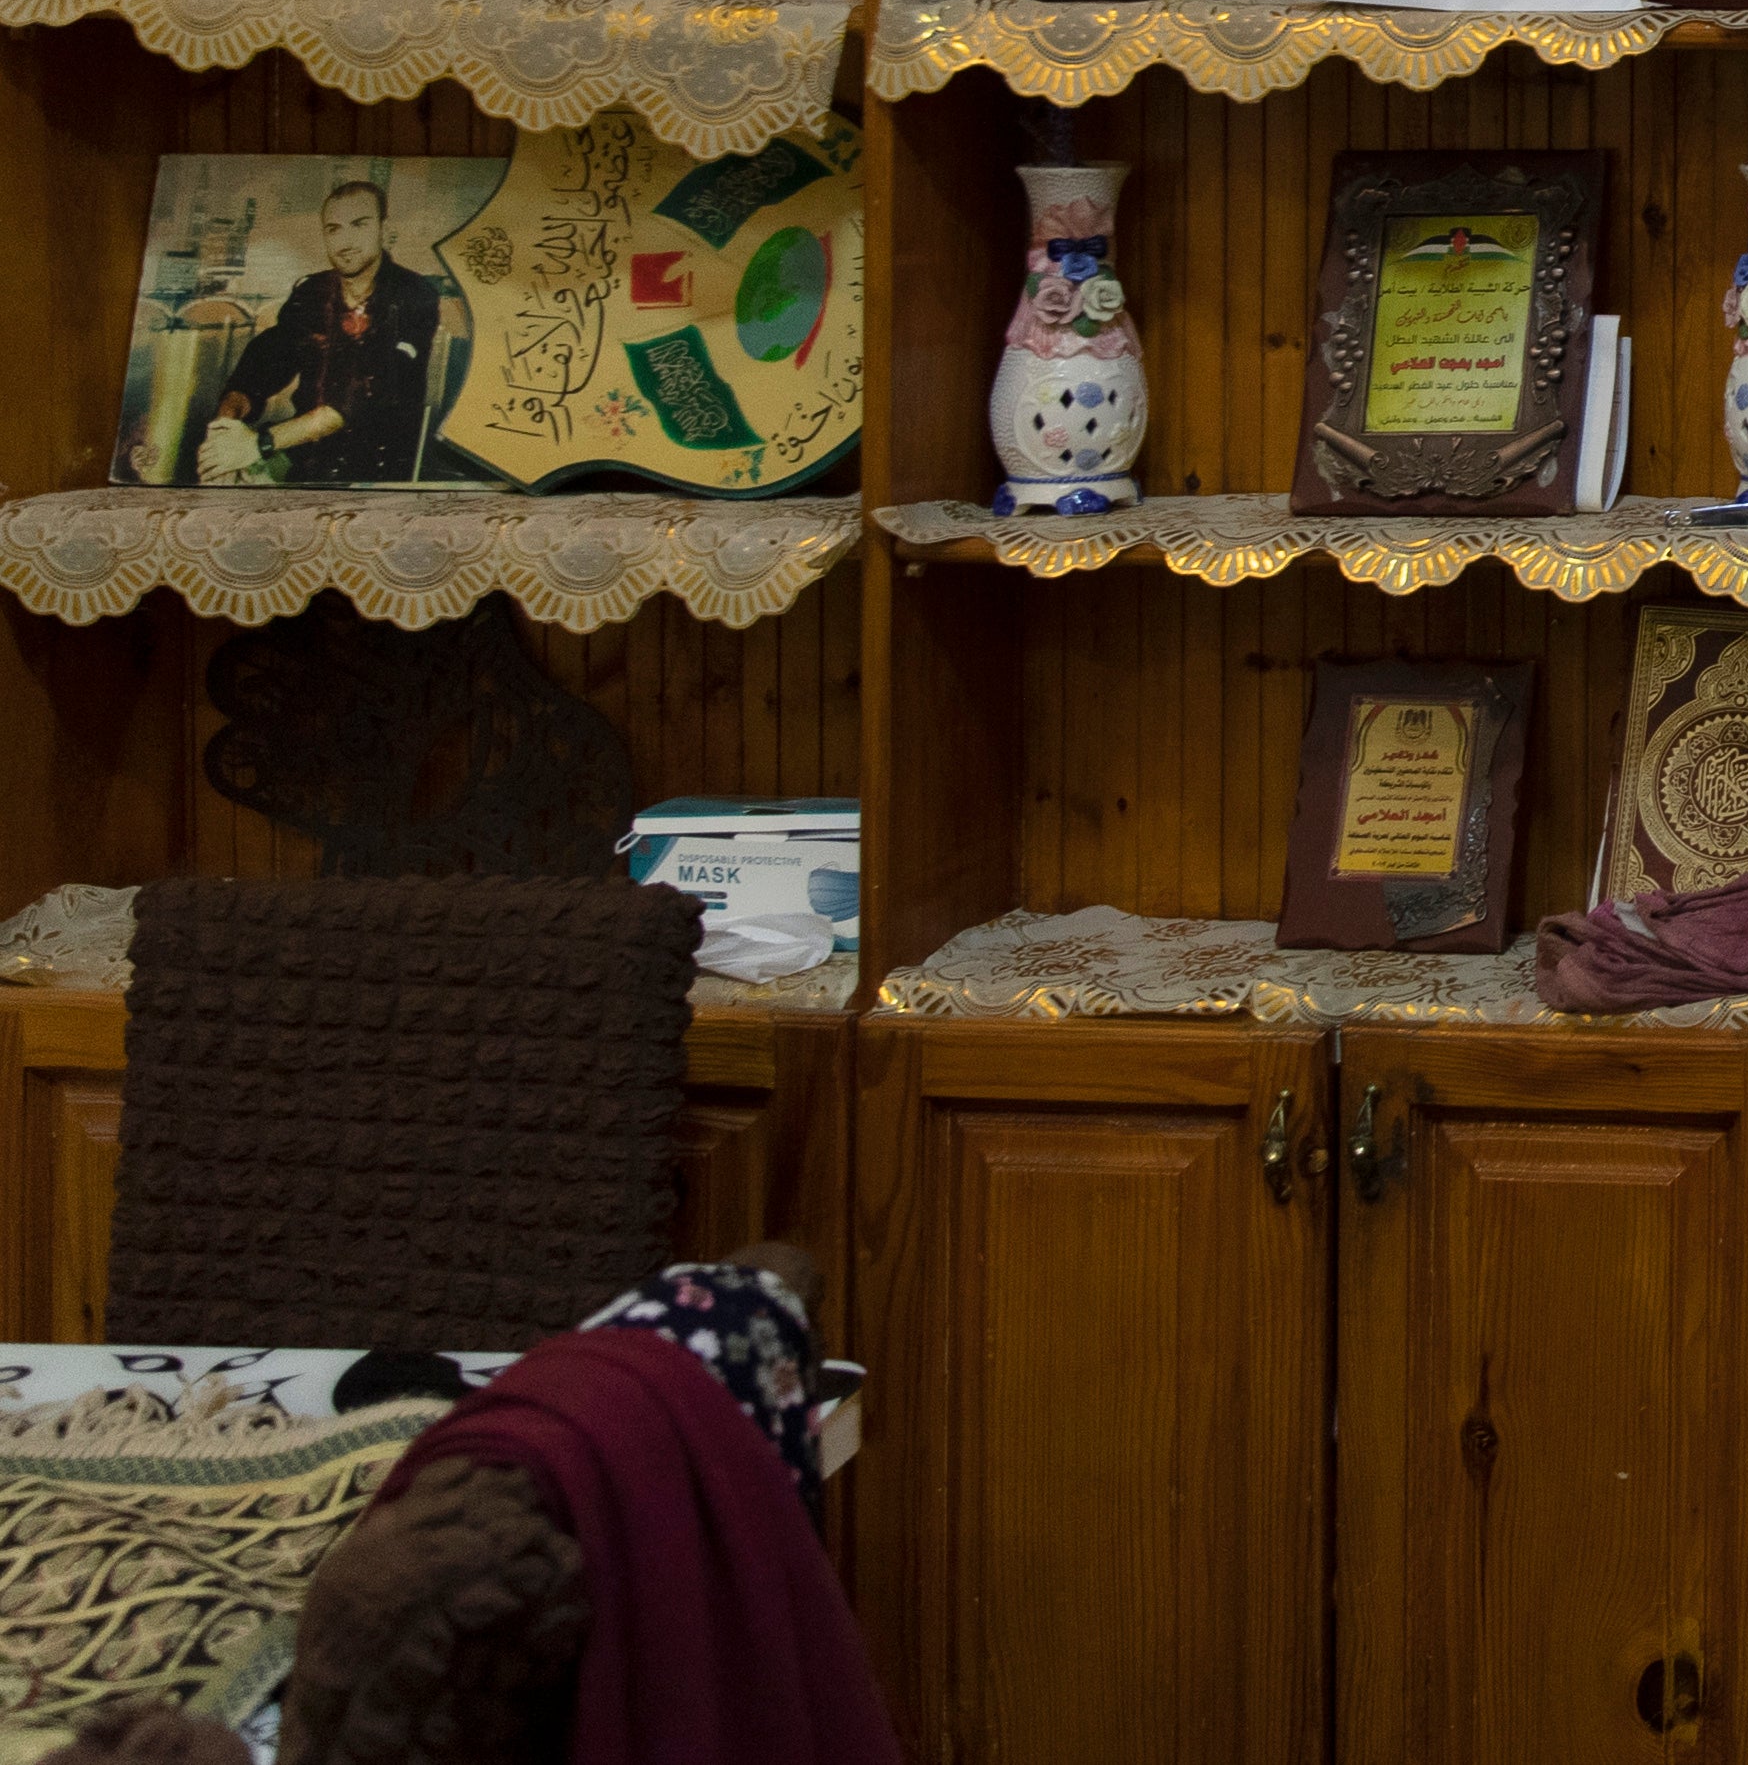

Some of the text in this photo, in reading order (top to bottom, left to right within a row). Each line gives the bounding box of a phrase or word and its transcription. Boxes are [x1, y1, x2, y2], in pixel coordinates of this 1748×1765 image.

[1396, 284, 1418, 298] بيت
[1427, 282, 1463, 297] الطلابية
[1466, 282, 1499, 297] الشبيبة
[1501, 280, 1532, 296] حركة
[1385, 334, 1418, 348] البطل
[1420, 332, 1460, 347] الشهيد
[1438, 356, 1473, 373] بهجت
[678, 853, 802, 867] DISPOSABLE PROTECTIVE
[678, 865, 741, 884] MASK
